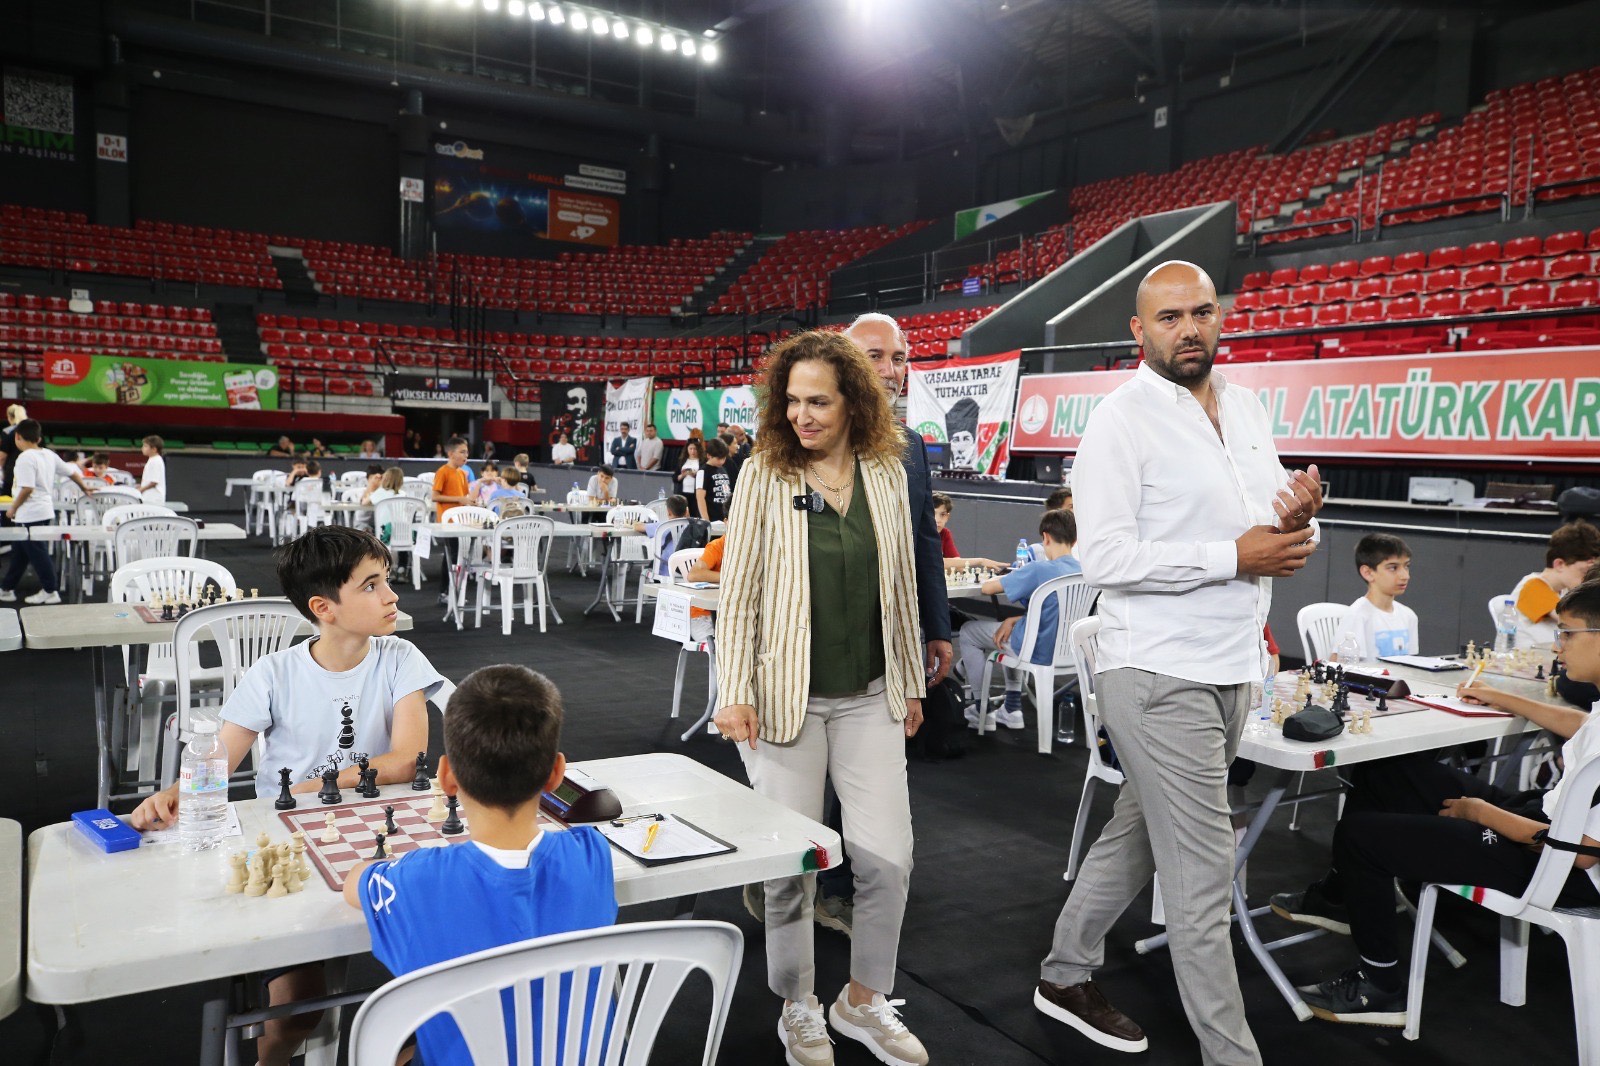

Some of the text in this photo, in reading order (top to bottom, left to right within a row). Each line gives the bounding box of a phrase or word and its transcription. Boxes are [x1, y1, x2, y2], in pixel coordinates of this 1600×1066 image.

[0, 124, 75, 153] RIM
[98, 147, 126, 160] BLOK
[970, 366, 1003, 381] TARAF
[935, 384, 988, 399] TUTMAKTIR
[1294, 368, 1499, 440] ATATÜRK
